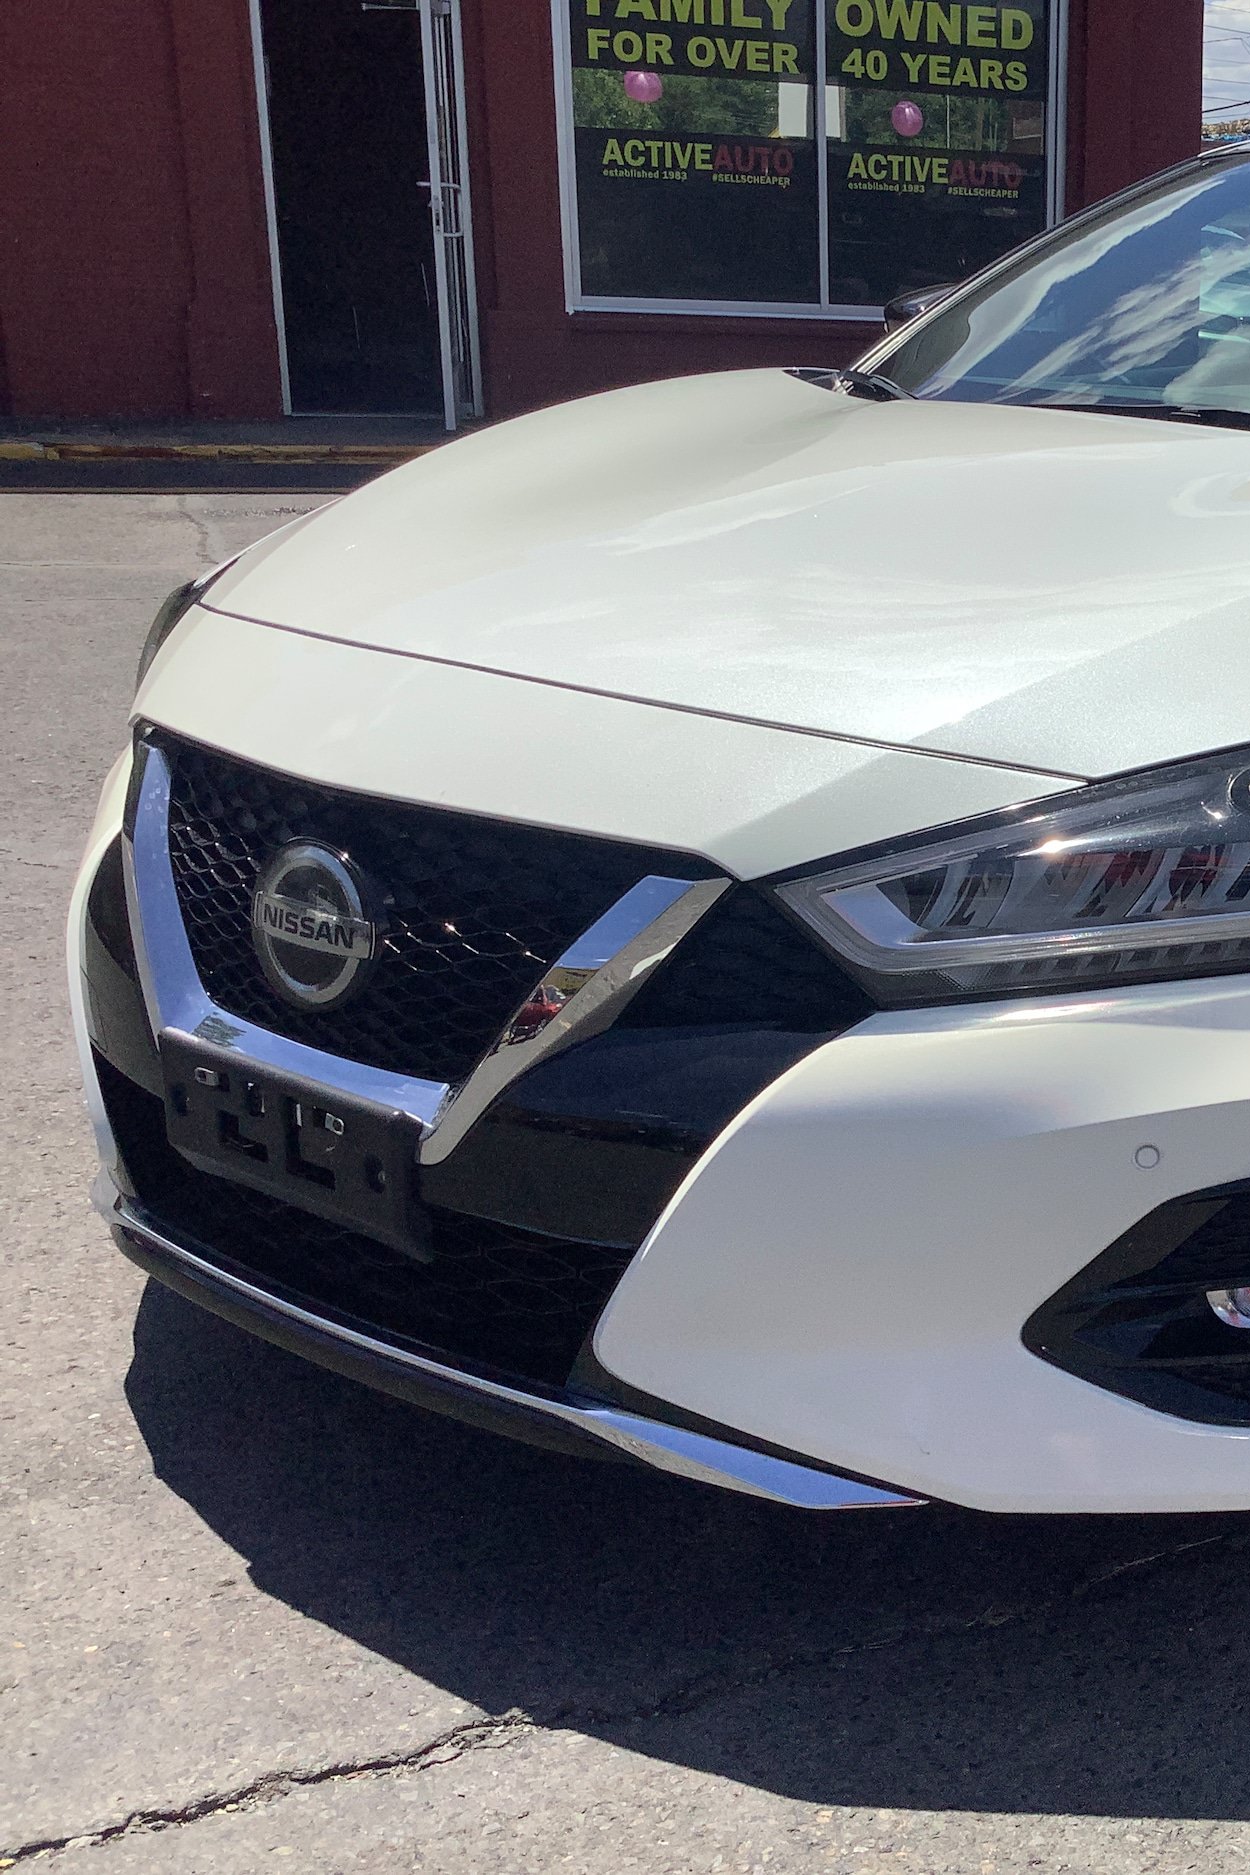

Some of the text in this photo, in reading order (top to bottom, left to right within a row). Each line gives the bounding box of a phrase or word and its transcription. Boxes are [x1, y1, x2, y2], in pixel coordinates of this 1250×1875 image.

[835, 0, 1034, 50] OWNED
[587, 28, 800, 74] FOR OVER
[841, 48, 1028, 92] 40 YEARS
[603, 168, 688, 181] established 1983
[712, 173, 791, 186] #SELLSCHEAPER
[848, 182, 925, 193] established 1983
[948, 186, 1019, 198] #SELLSCHEAPER
[264, 903, 354, 949] NISSAN
